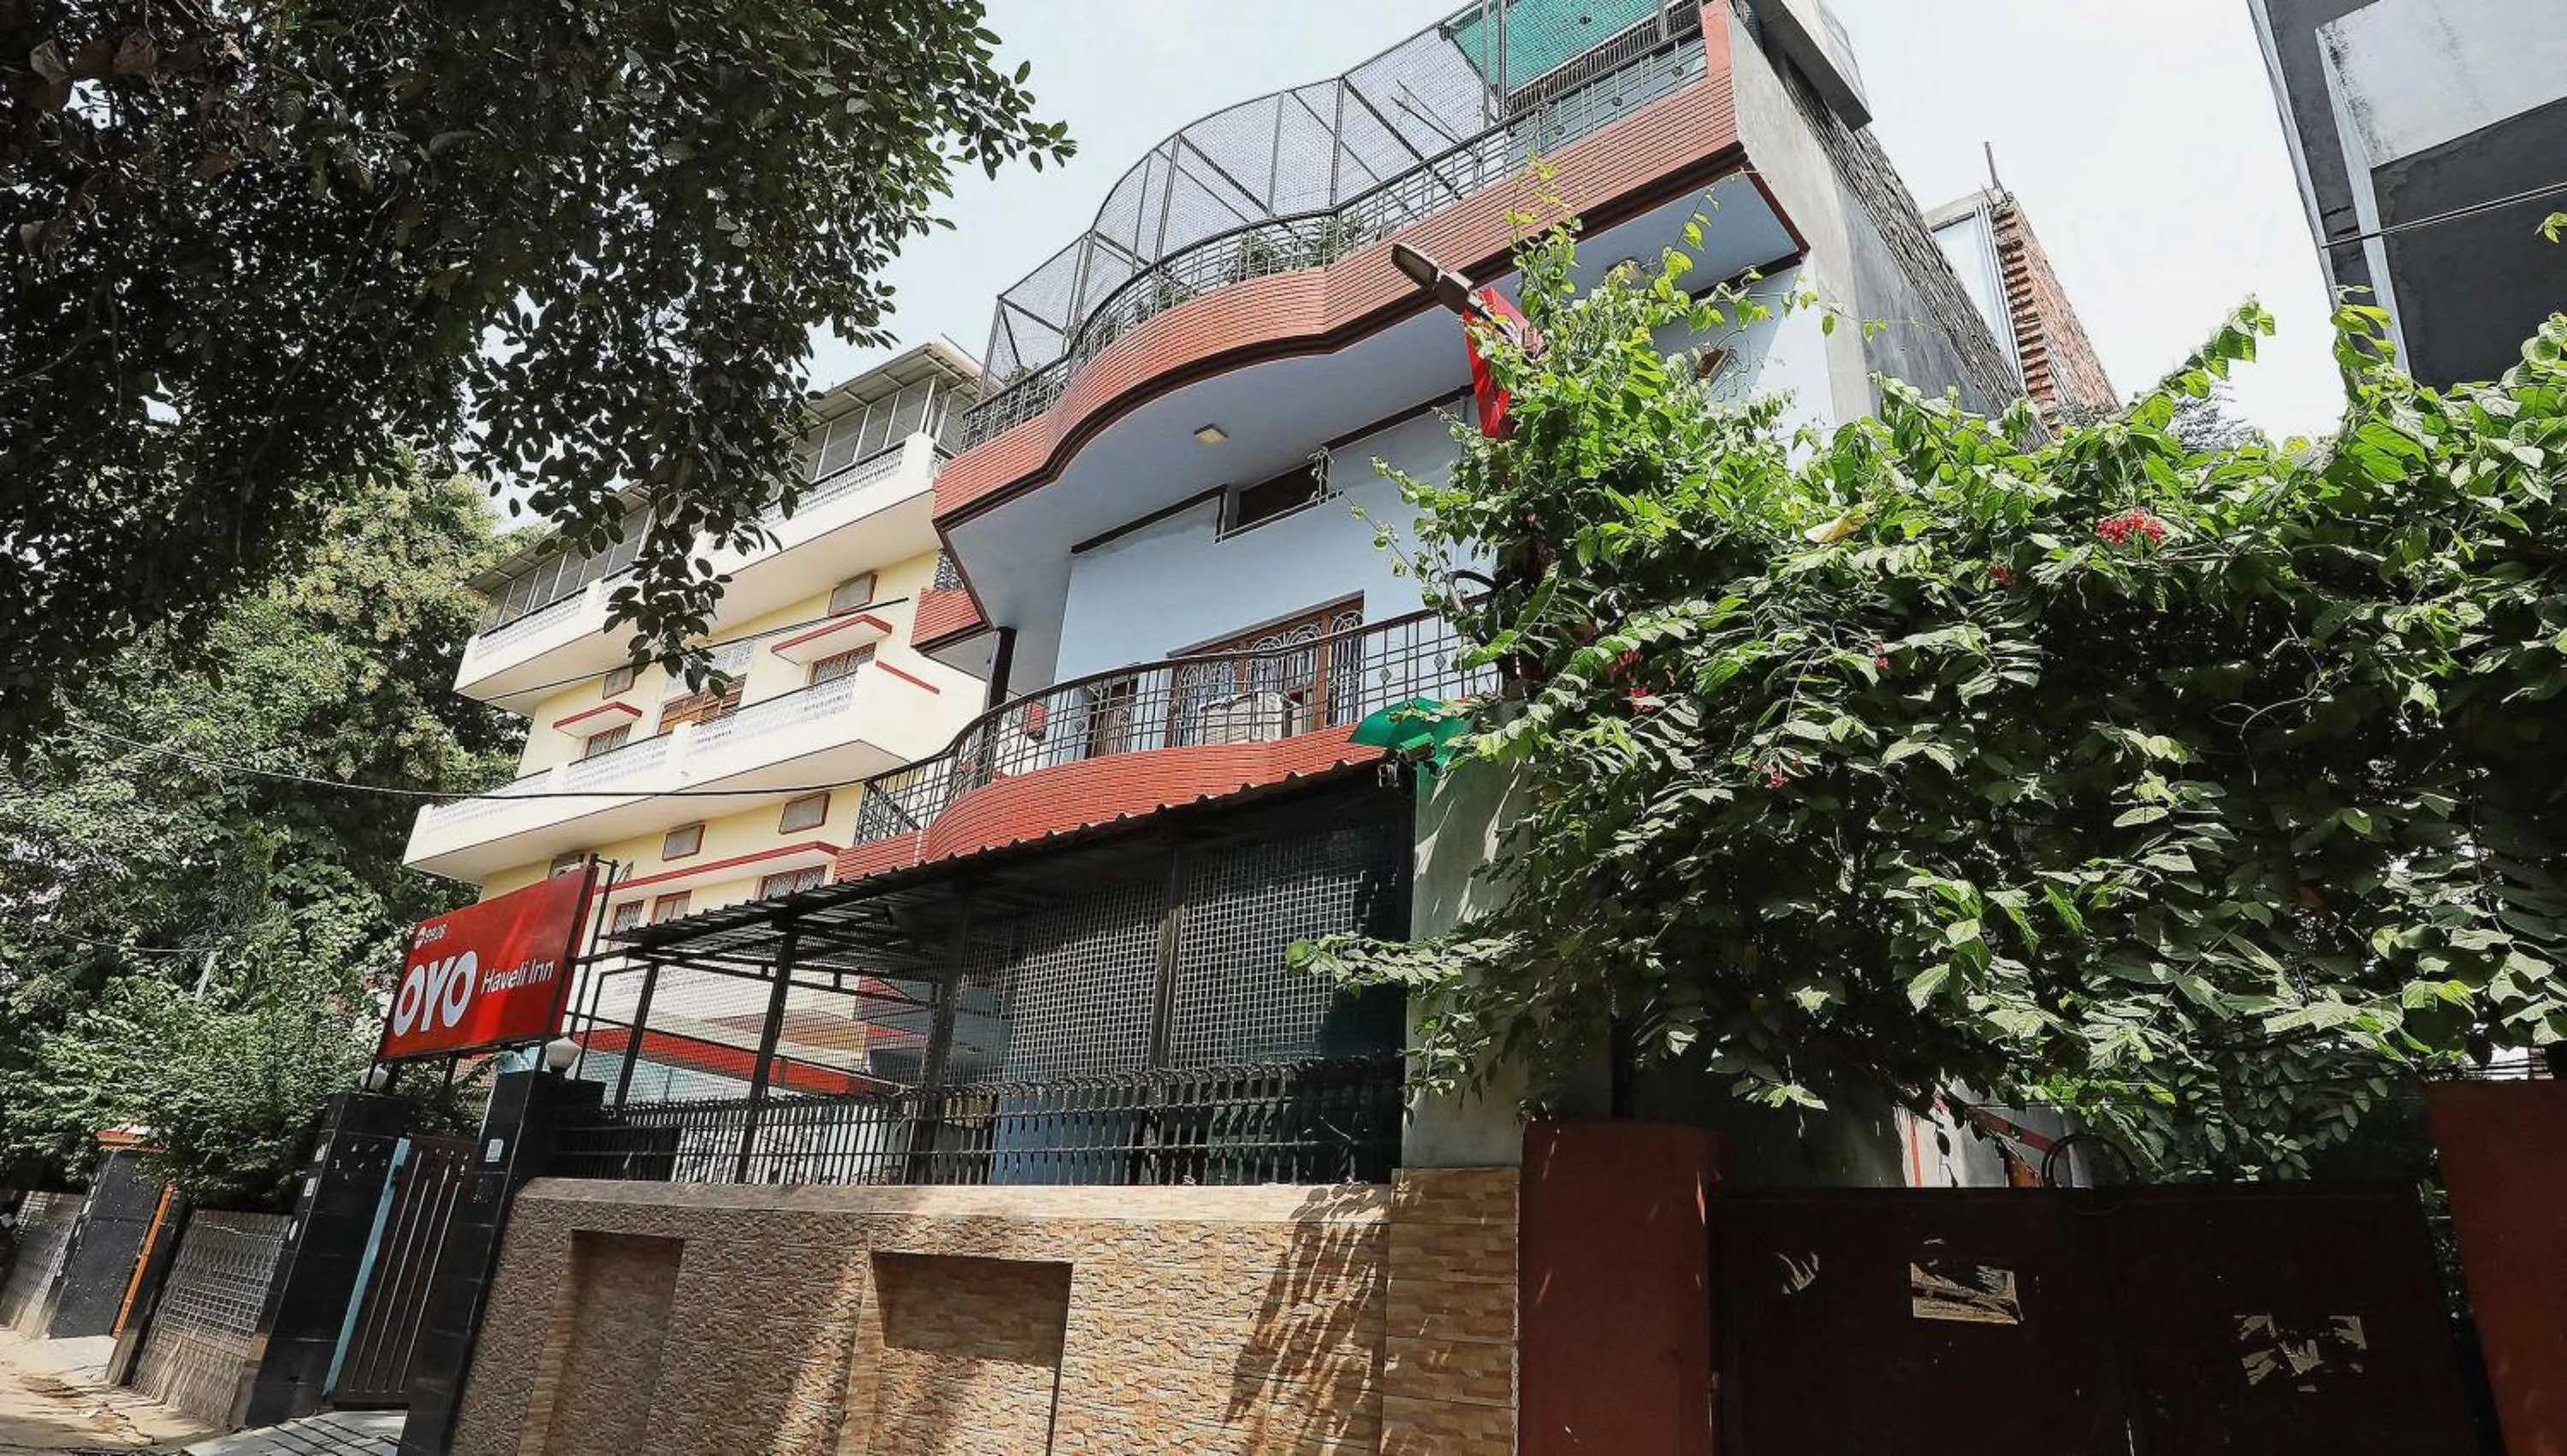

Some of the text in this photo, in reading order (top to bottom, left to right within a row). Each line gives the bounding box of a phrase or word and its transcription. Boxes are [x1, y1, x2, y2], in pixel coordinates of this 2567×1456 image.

[393, 950, 555, 1038] OYO Haveli Inn
